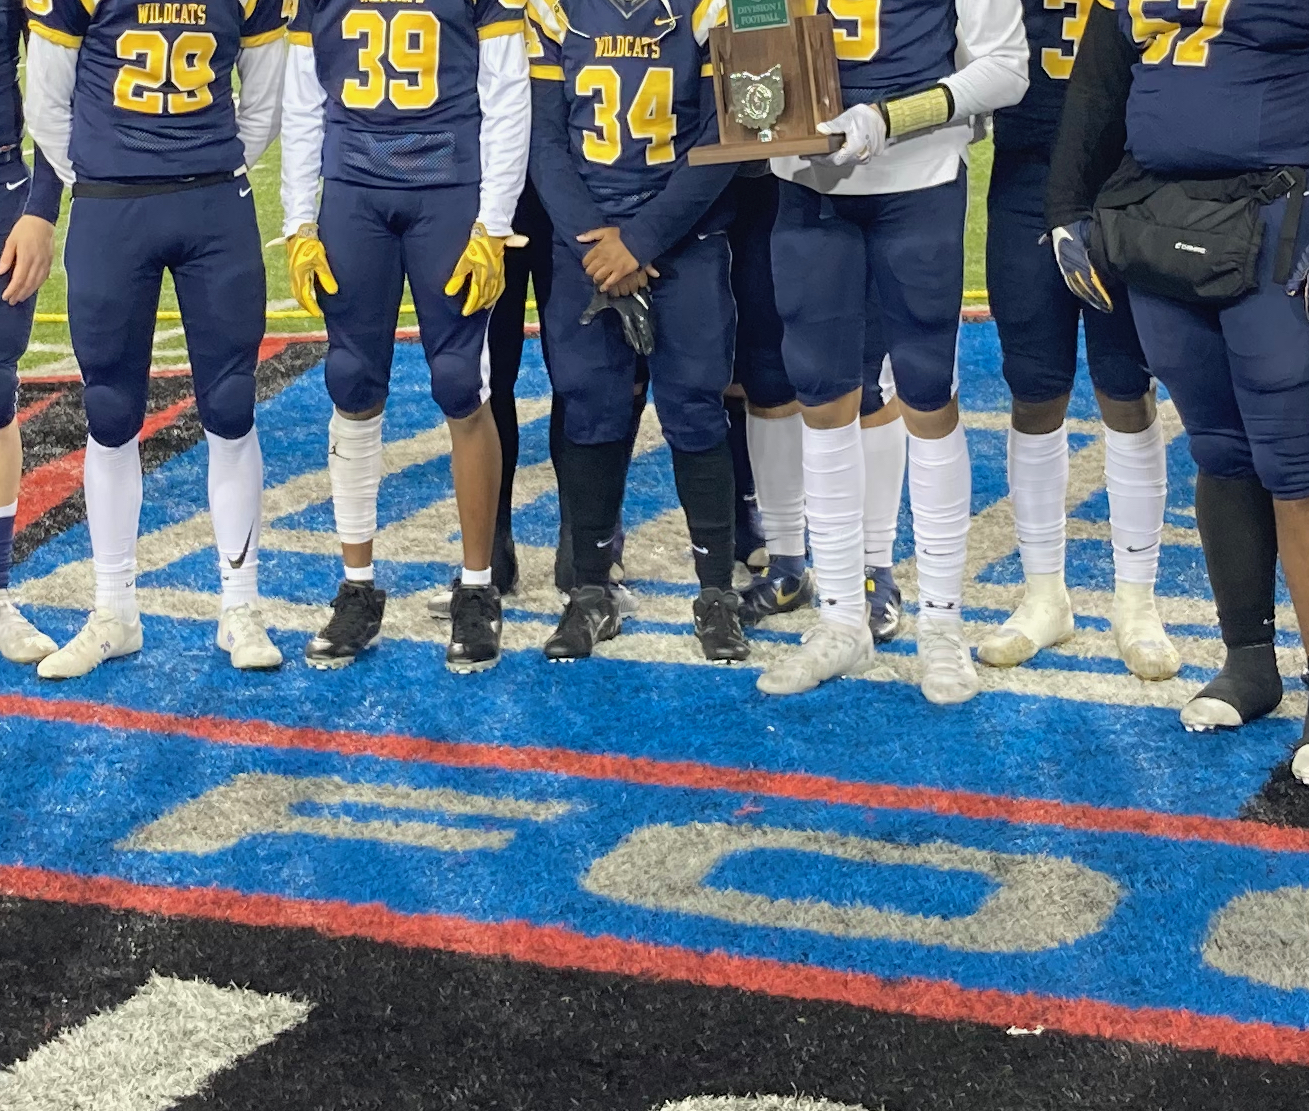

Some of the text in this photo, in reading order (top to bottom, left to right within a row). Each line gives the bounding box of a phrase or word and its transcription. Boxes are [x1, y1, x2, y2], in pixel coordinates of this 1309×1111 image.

[137, 2, 207, 26] WILDCATS
[737, 3, 777, 15] DIVISION
[740, 12, 780, 25] FOOTBALL
[595, 35, 661, 59] WILDCATS
[341, 9, 440, 110] 39
[114, 30, 217, 114] 29
[576, 65, 677, 165] 34
